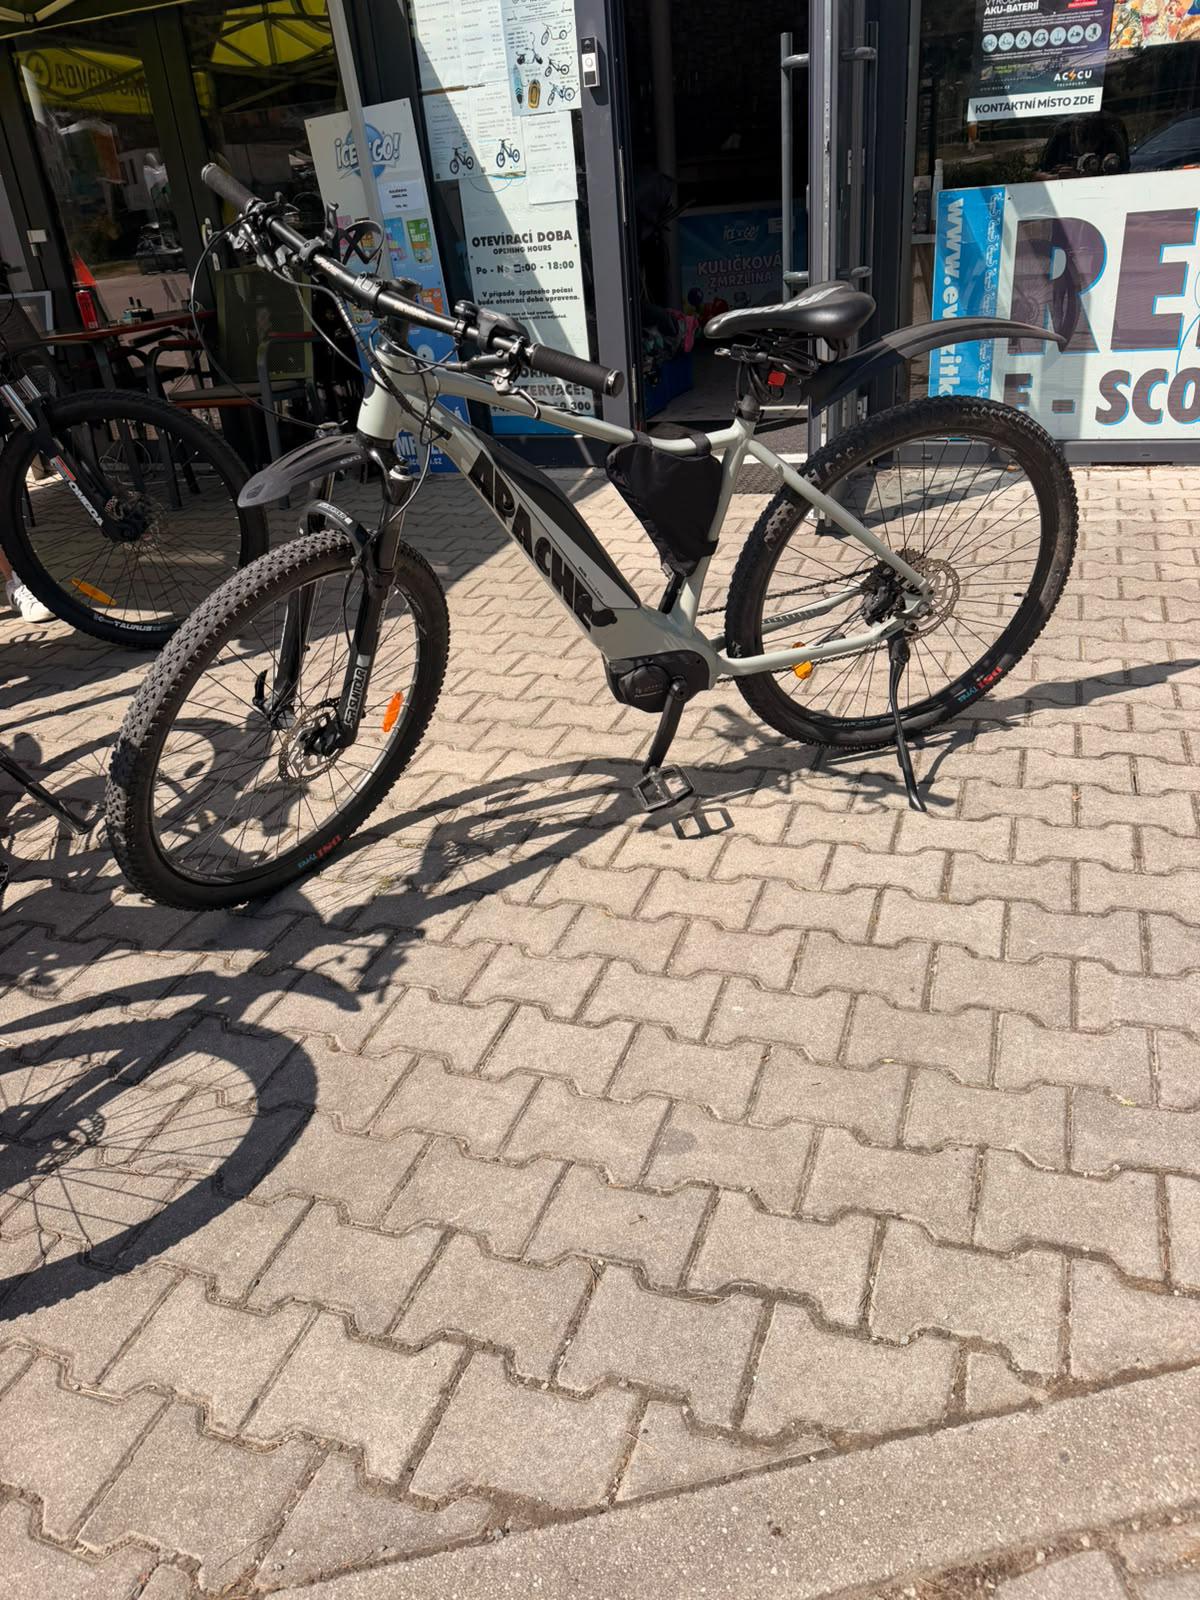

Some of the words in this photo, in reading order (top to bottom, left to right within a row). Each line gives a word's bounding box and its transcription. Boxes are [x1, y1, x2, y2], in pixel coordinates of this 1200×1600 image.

[975, 97, 1036, 114] KONTAKTNÍ
[1037, 95, 1071, 108] MÍSTO
[1073, 95, 1095, 105] ZDE
[471, 229, 533, 248] OTEVÍRACÍ
[537, 229, 573, 243] DOBA
[492, 246, 525, 255] OPENING
[527, 244, 552, 252] HOURS
[476, 266, 488, 275] Po
[547, 260, 575, 270] 18:00
[698, 250, 782, 275] KULIČKOVÁ
[709, 272, 771, 288] ZMRZLINA
[1007, 207, 1200, 356] RE
[67, 481, 104, 527] OMEGA
[467, 450, 592, 633] APACHE
[348, 666, 368, 709] SUNTOUR
